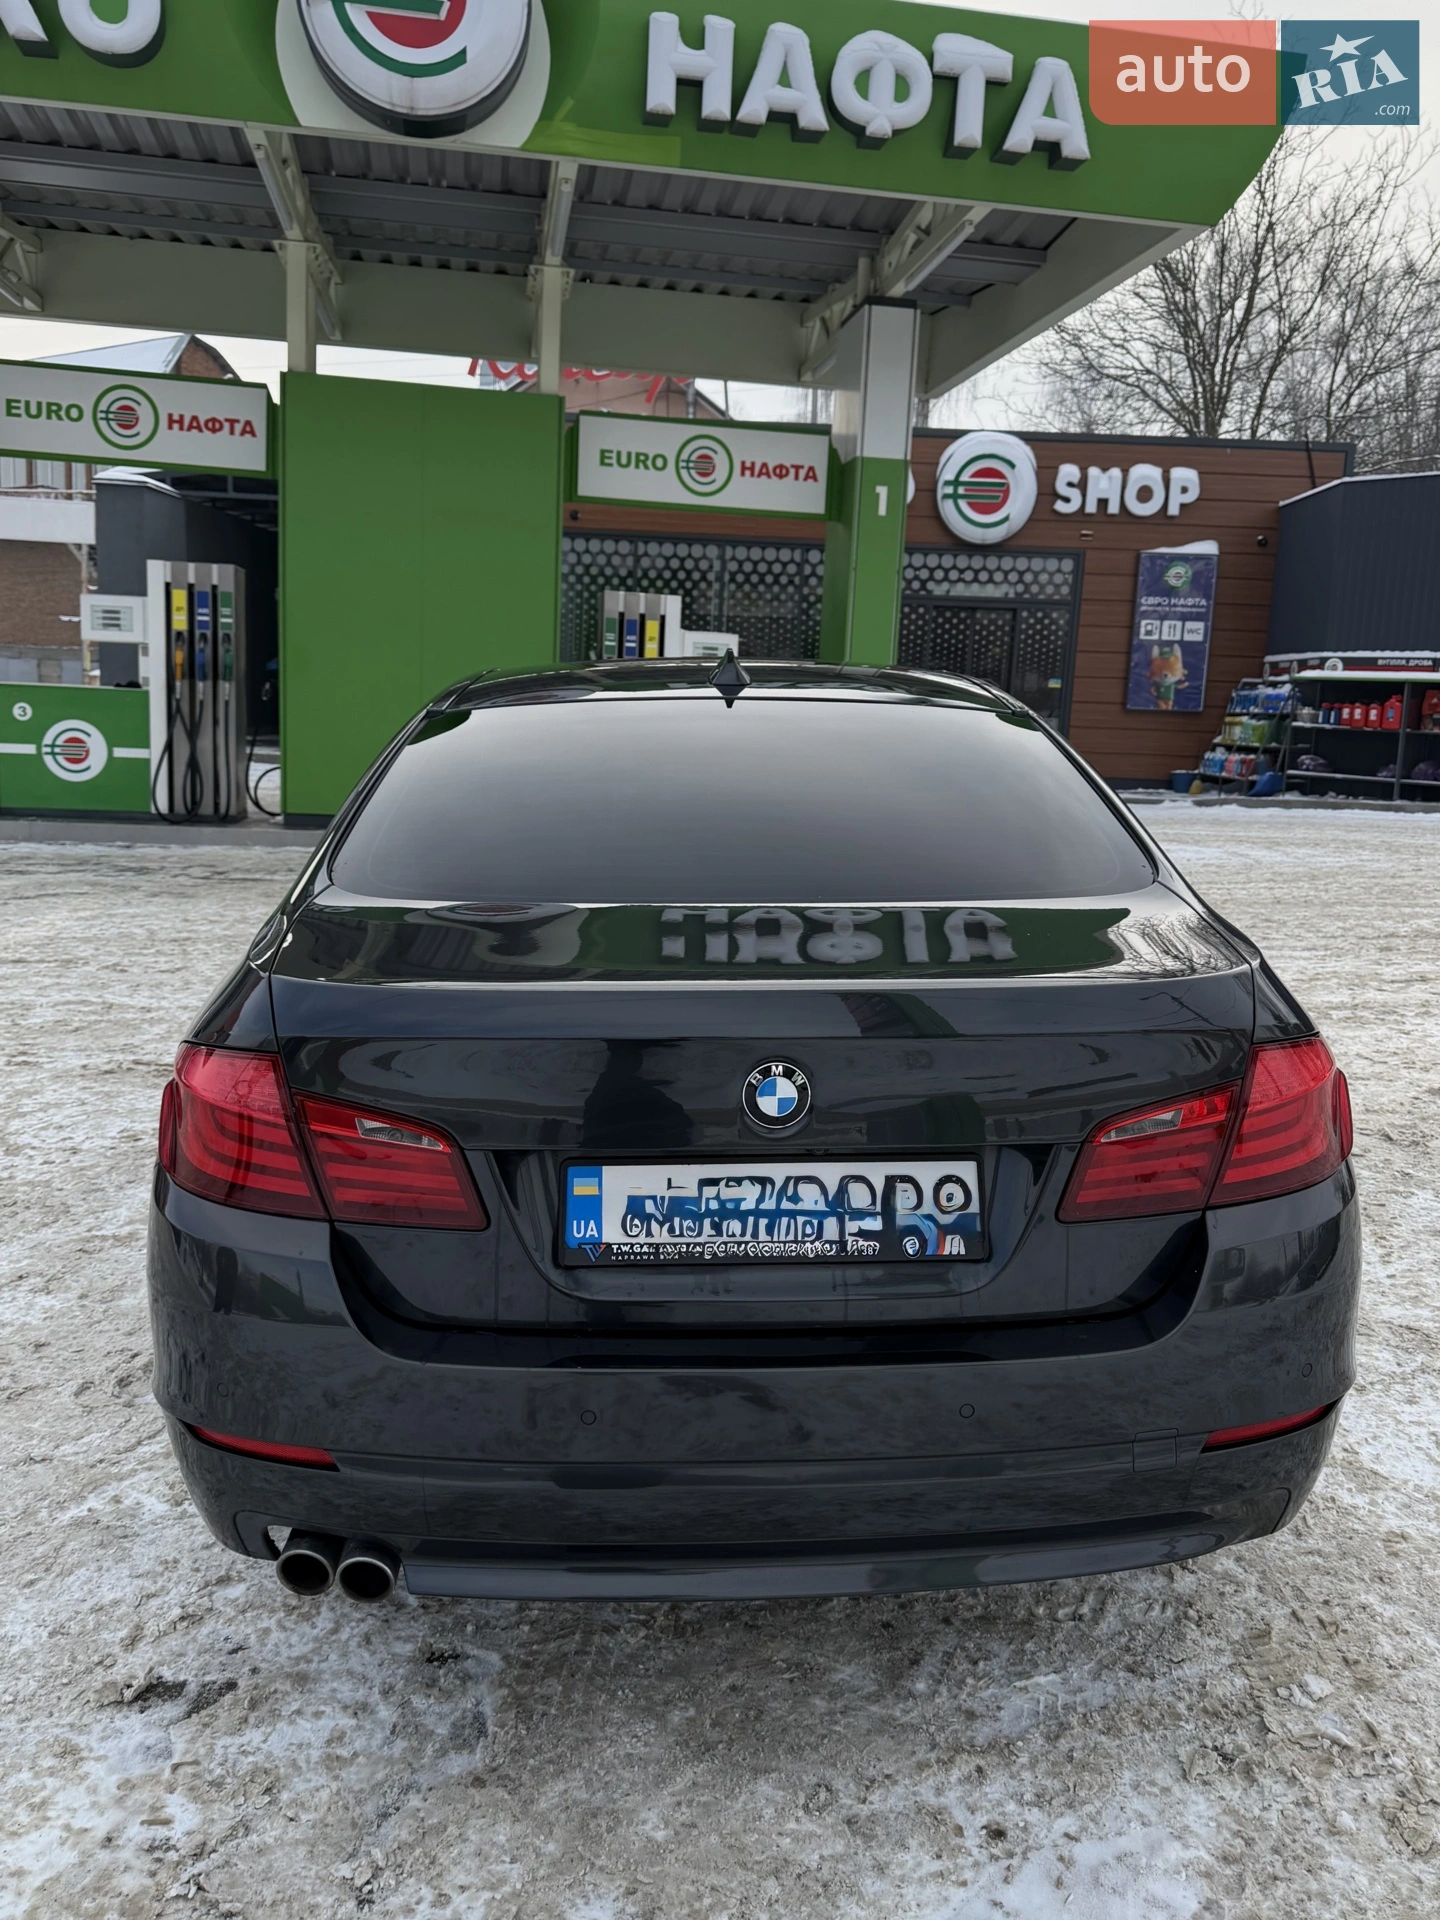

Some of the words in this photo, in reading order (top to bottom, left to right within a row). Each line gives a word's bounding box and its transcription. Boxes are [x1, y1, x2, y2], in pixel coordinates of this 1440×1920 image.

[646, 11, 1091, 161] НАФТА
[5, 398, 85, 423] EURO
[166, 412, 258, 438] НАФТА
[598, 448, 669, 472] EURO
[739, 460, 819, 483] НАФТА
[874, 485, 888, 516] 1
[1053, 463, 1201, 517] SHOP
[1170, 597, 1207, 606] НАФТА
[18, 705, 28, 717] 3
[749, 1065, 805, 1087] BMW
[572, 1219, 599, 1238] UA
